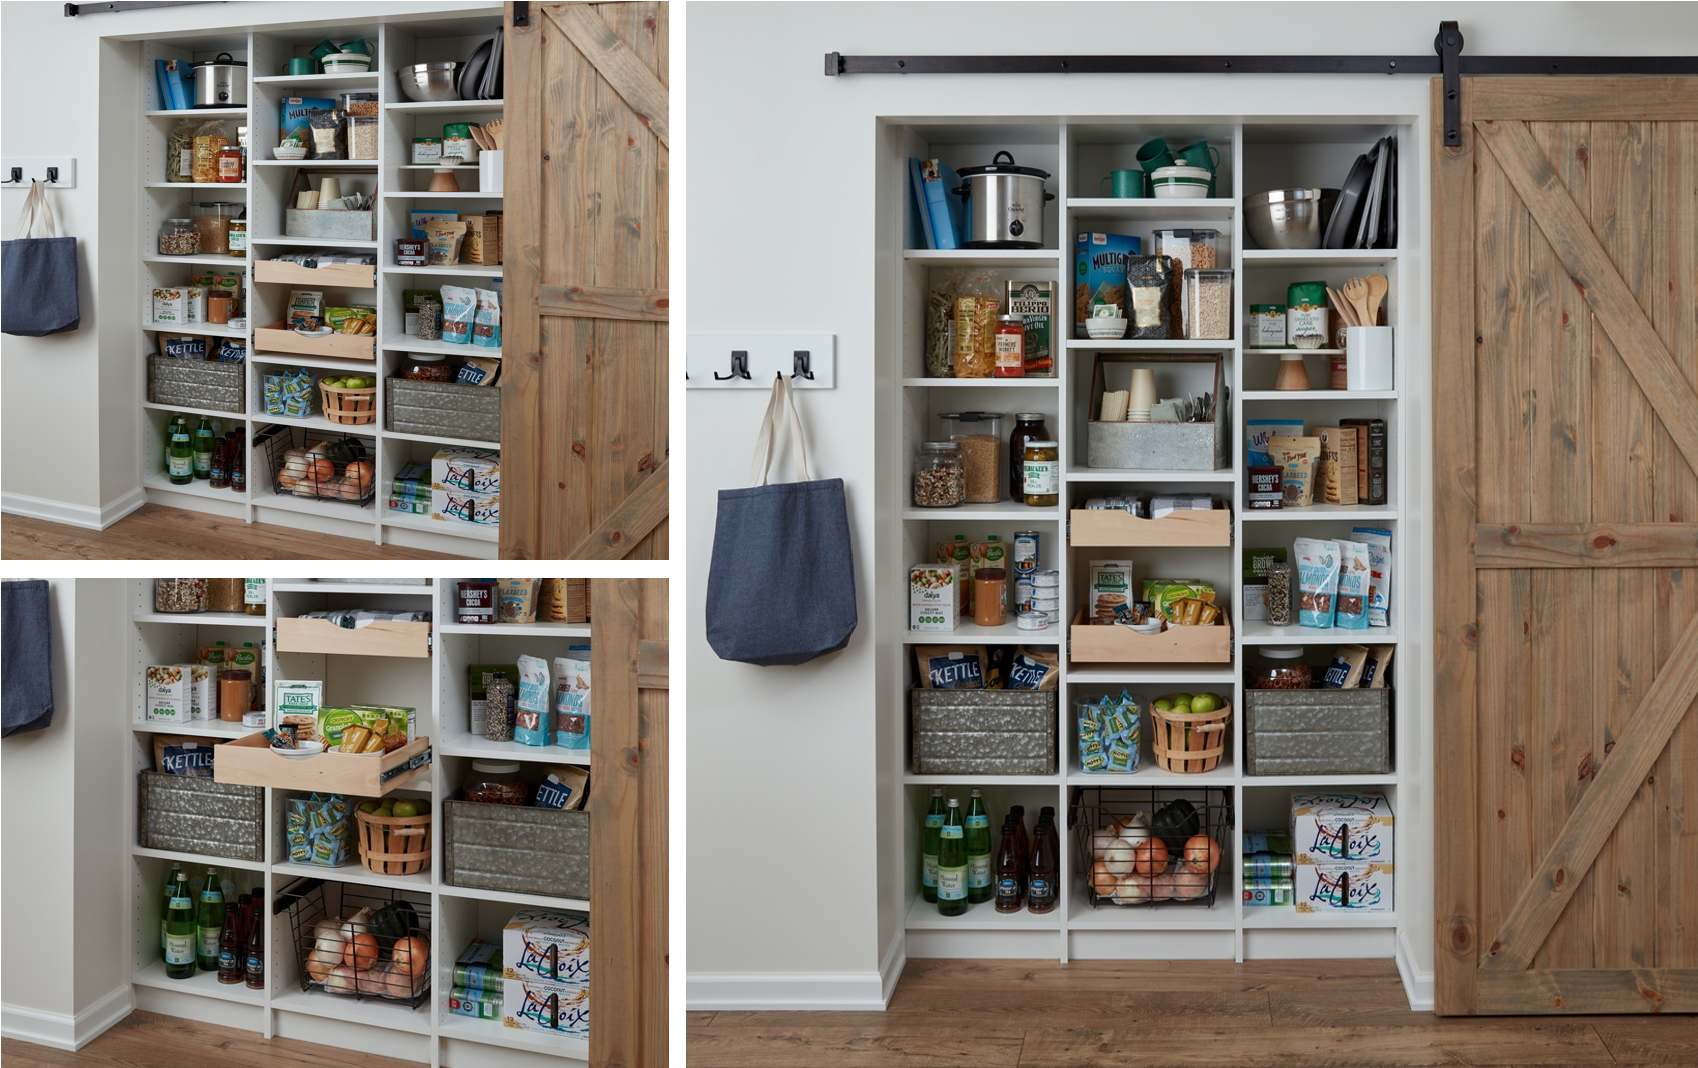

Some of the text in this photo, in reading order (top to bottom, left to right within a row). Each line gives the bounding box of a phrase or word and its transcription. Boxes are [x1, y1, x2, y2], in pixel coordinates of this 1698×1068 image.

[1092, 252, 1127, 270] MULTIG
[165, 342, 204, 355] KETTLE
[458, 368, 483, 384] ETTLE
[1252, 475, 1279, 484] HERSHEY'S
[1253, 560, 1273, 569] GROW
[1100, 573, 1122, 581] TATE'S
[461, 589, 488, 599] HERSHEY'S
[466, 598, 481, 606] COCOA
[929, 661, 980, 686] KETTLE
[1011, 662, 1044, 685] KETTLE
[158, 686, 171, 694] daiya
[287, 694, 311, 703] TATE'S
[331, 715, 353, 723] CRUNCHY
[162, 752, 213, 770] KETTLE
[536, 784, 568, 808] ETTLE
[940, 873, 958, 882] Mineral
[169, 940, 187, 948] Mineral
[543, 985, 566, 993] COCONUT
